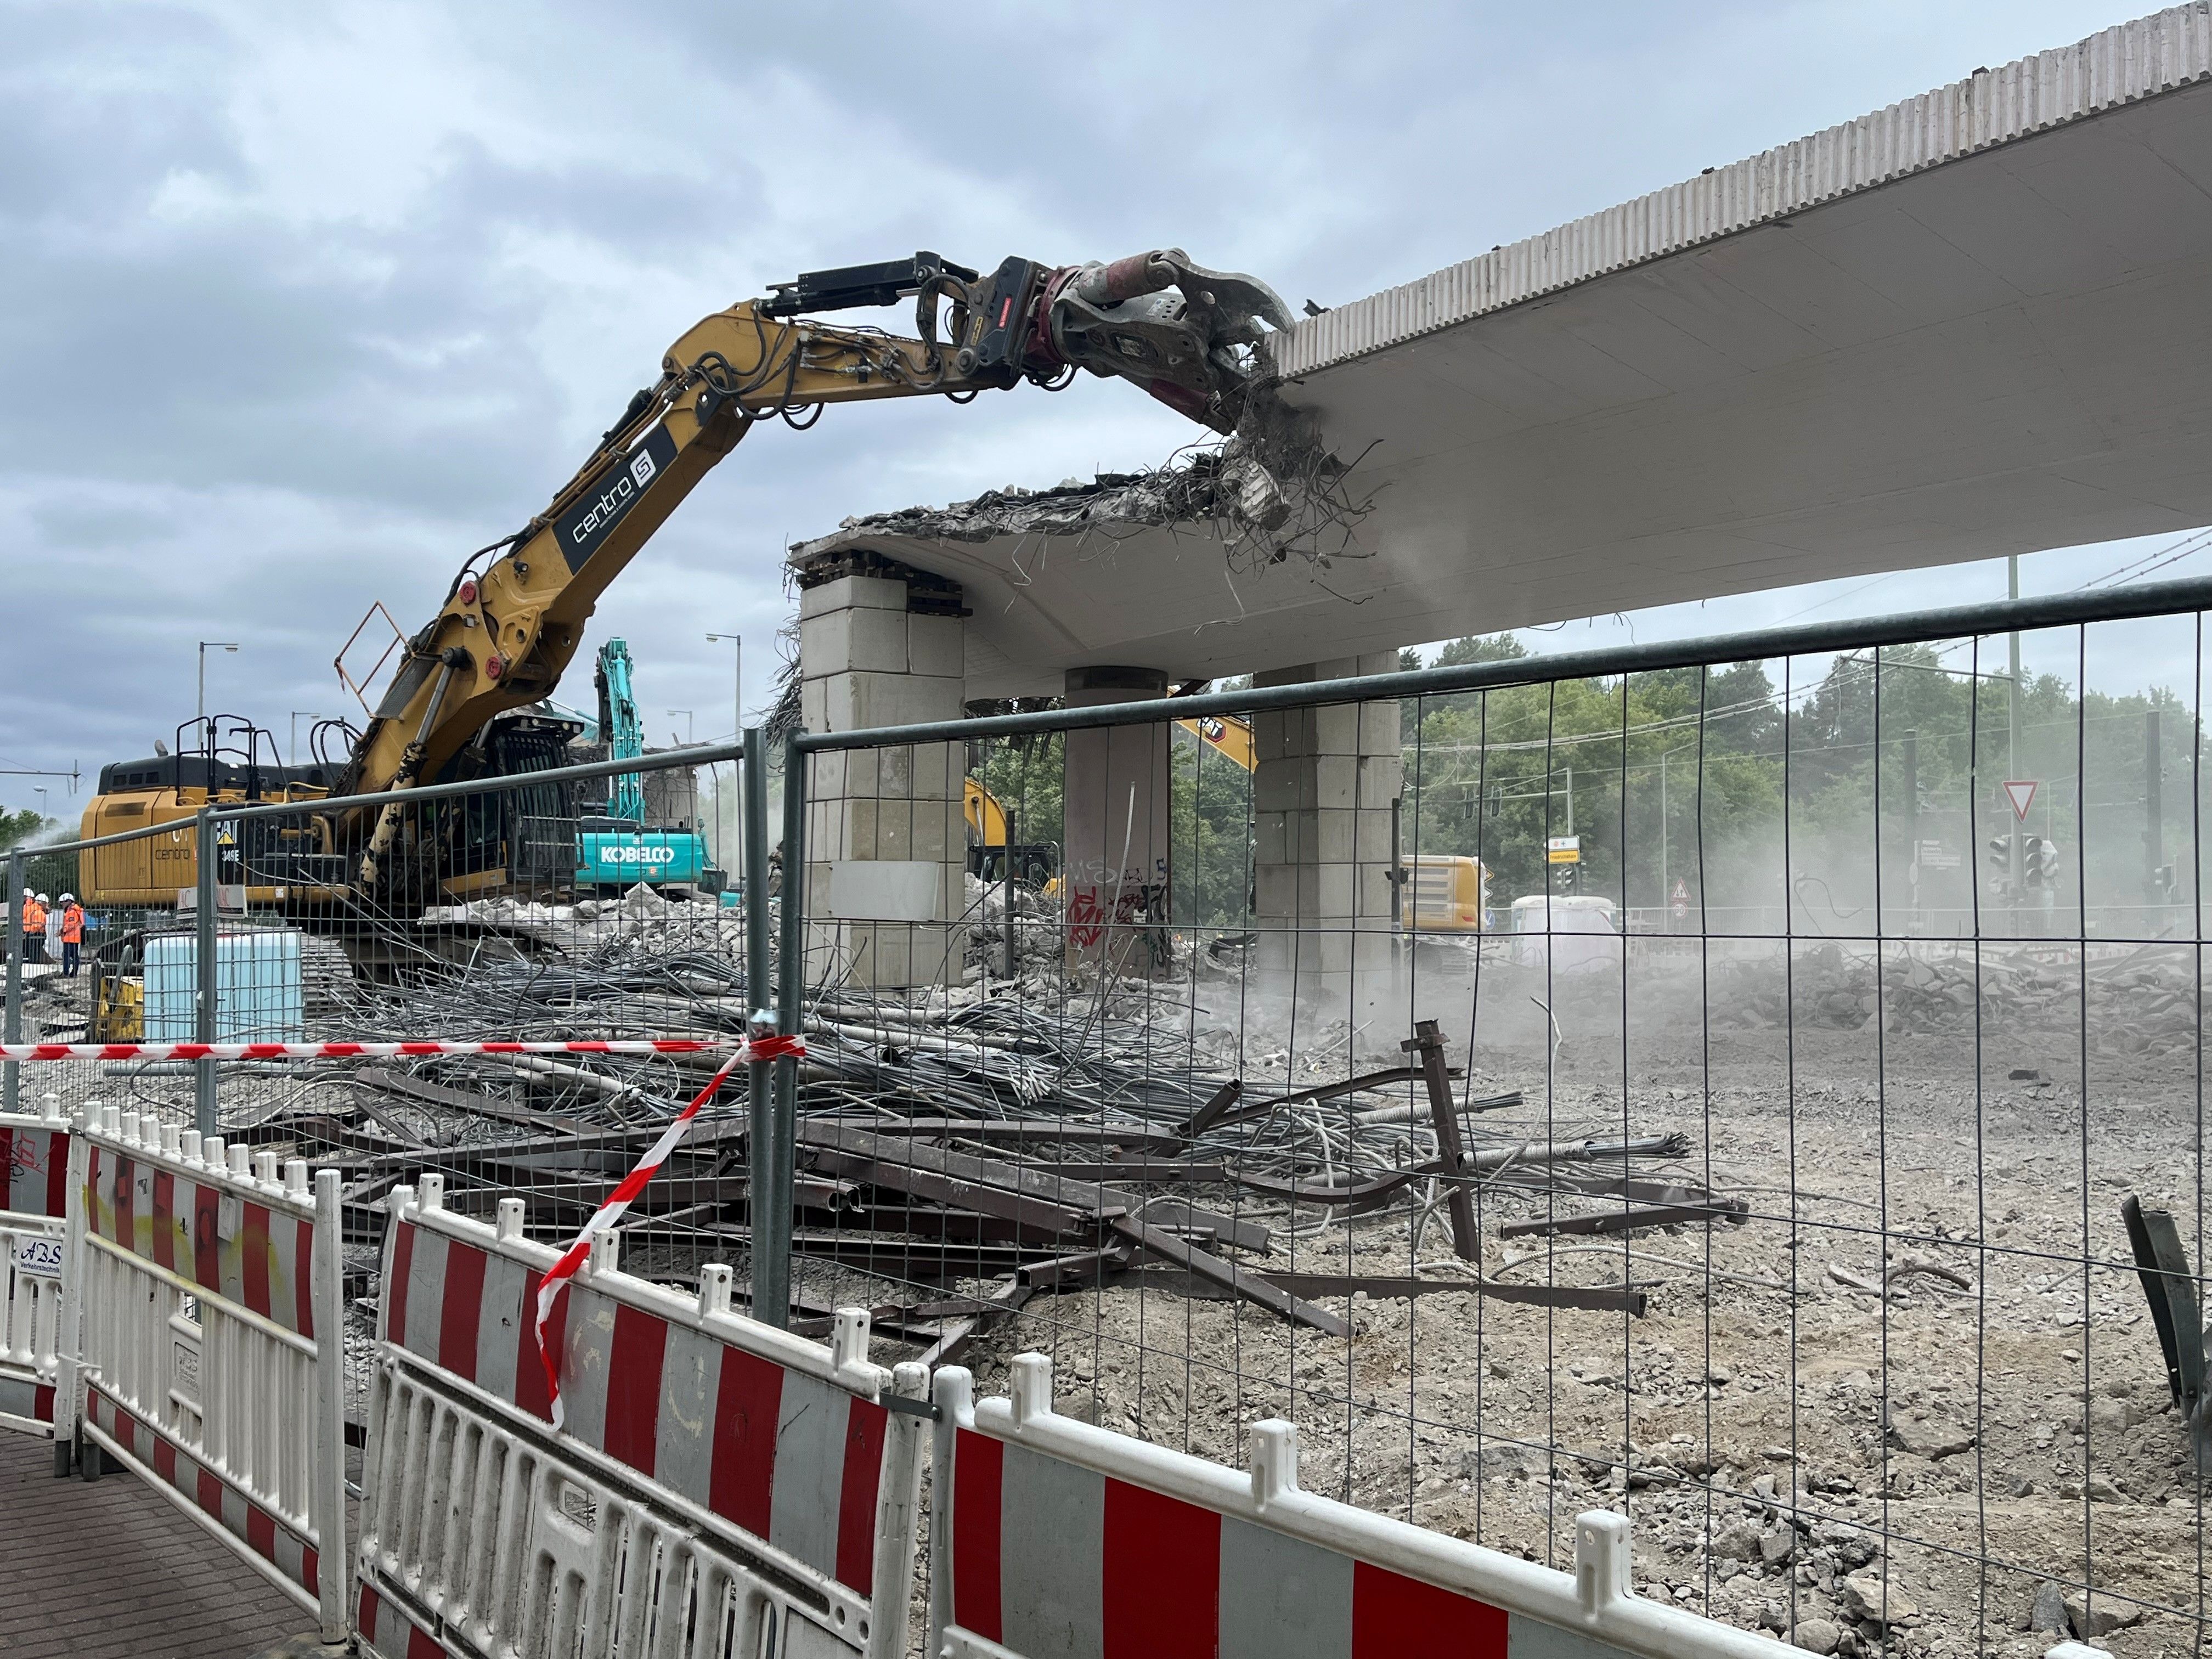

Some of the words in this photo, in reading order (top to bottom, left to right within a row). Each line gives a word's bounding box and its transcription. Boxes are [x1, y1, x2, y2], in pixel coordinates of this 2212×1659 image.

[572, 477, 631, 543] centro
[155, 849, 190, 860] centro
[601, 847, 675, 863] KOBELCO
[20, 1242, 61, 1265] ABS
[20, 1261, 60, 1274] Verkehrstechnik
